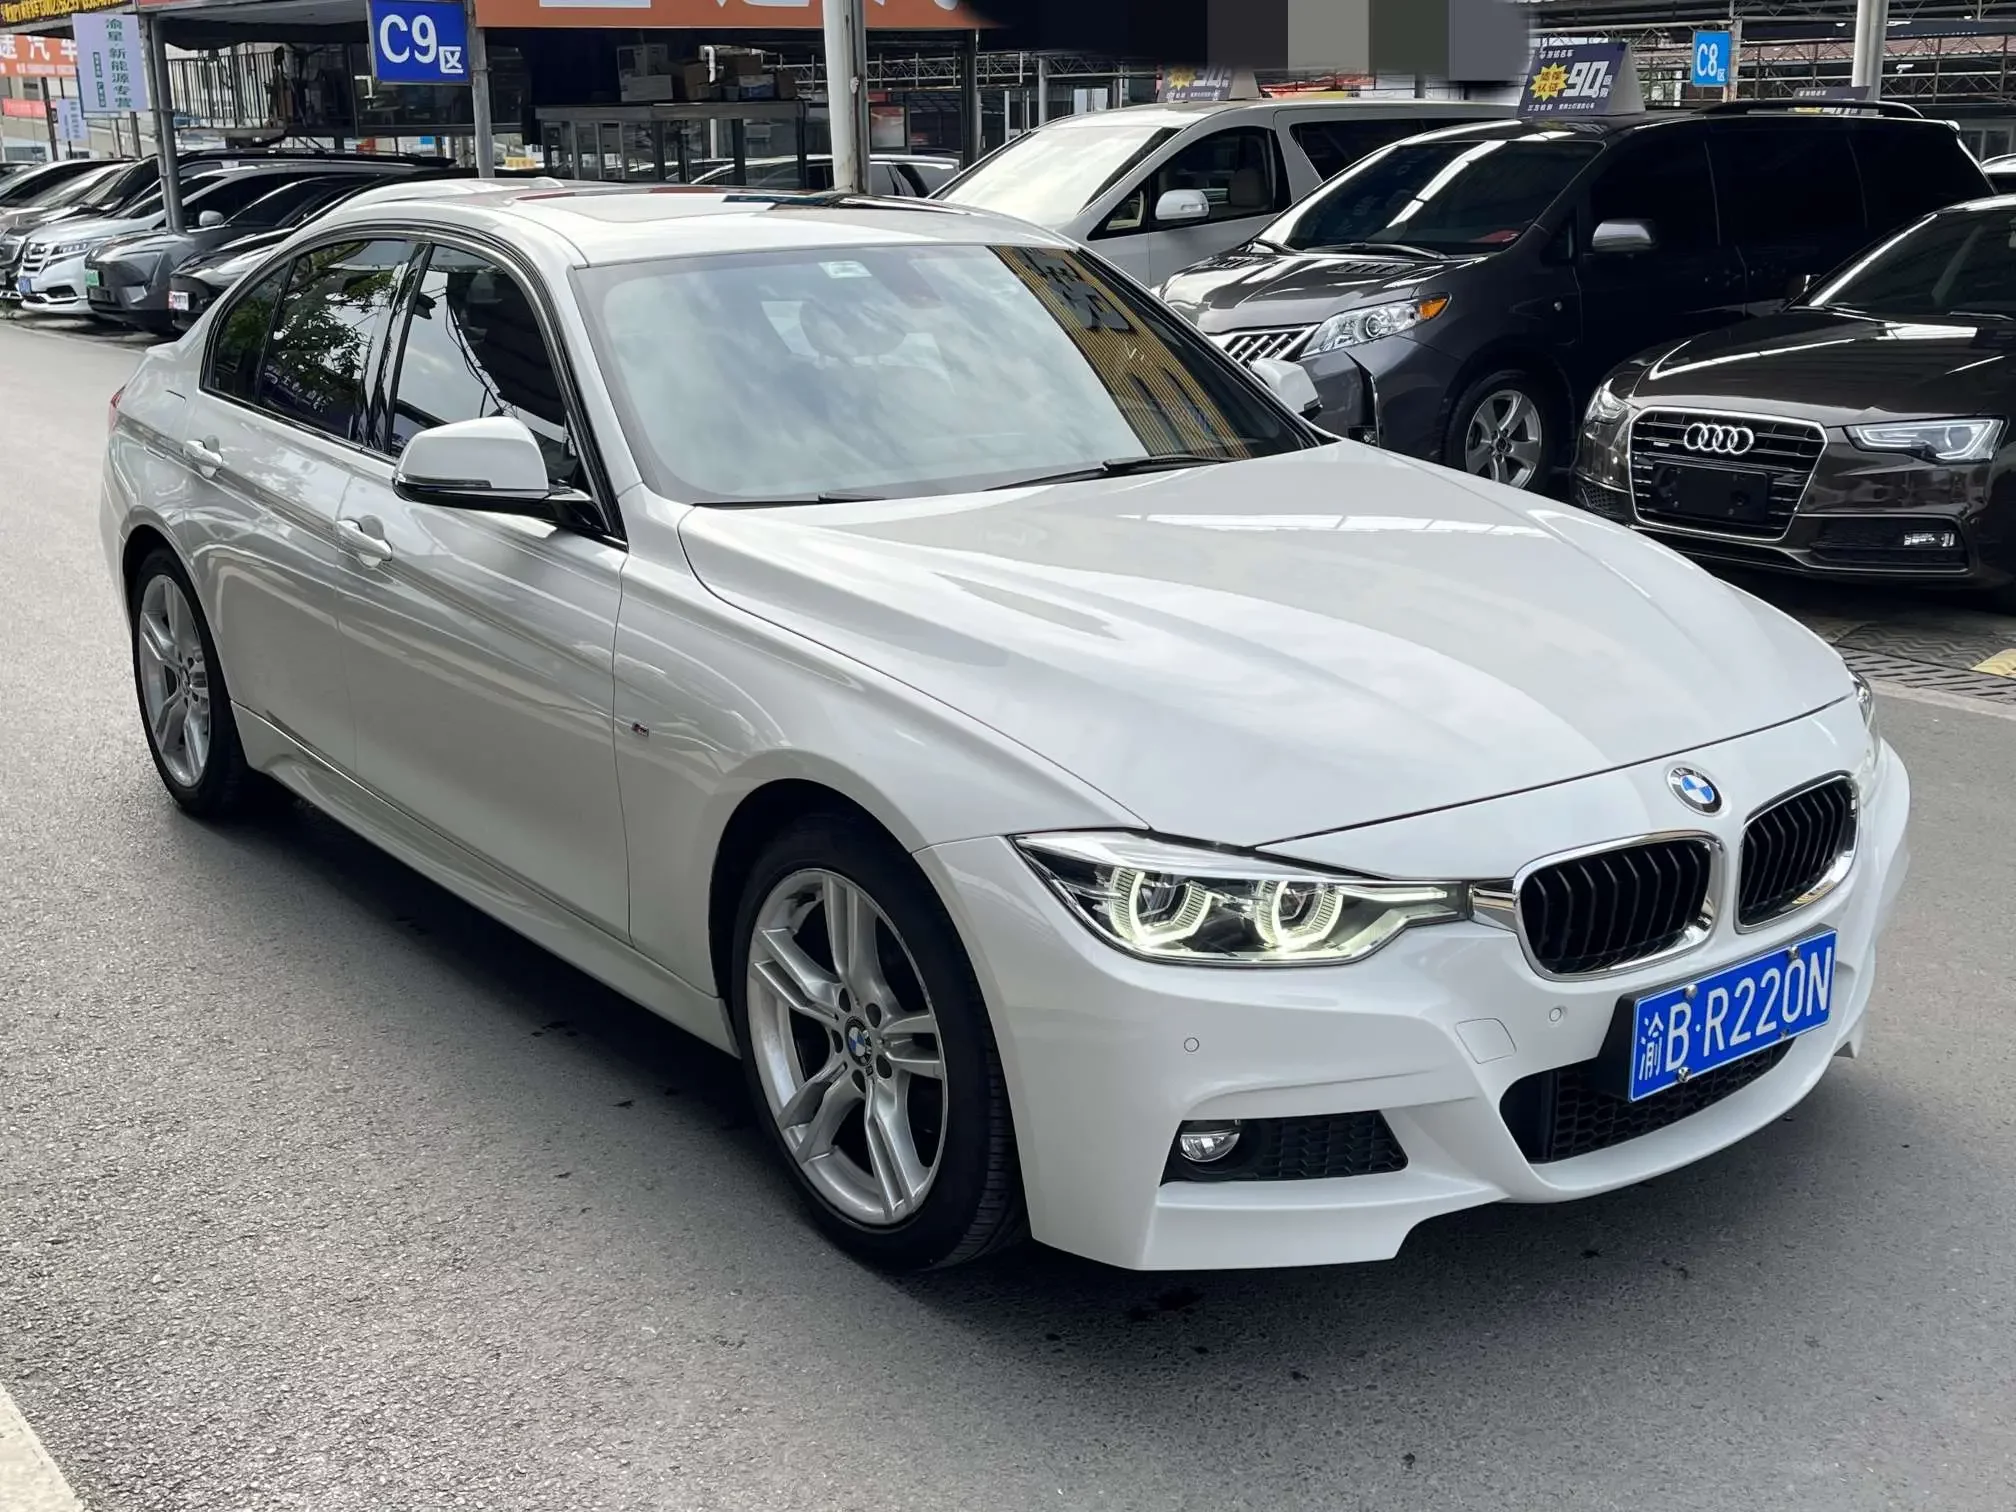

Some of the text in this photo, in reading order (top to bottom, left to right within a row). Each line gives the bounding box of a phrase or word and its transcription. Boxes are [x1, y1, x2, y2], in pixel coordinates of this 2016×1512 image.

[379, 14, 464, 74] C9区
[1697, 43, 1726, 82] C8区
[1638, 946, 1833, 1081] 渝B·R220N
